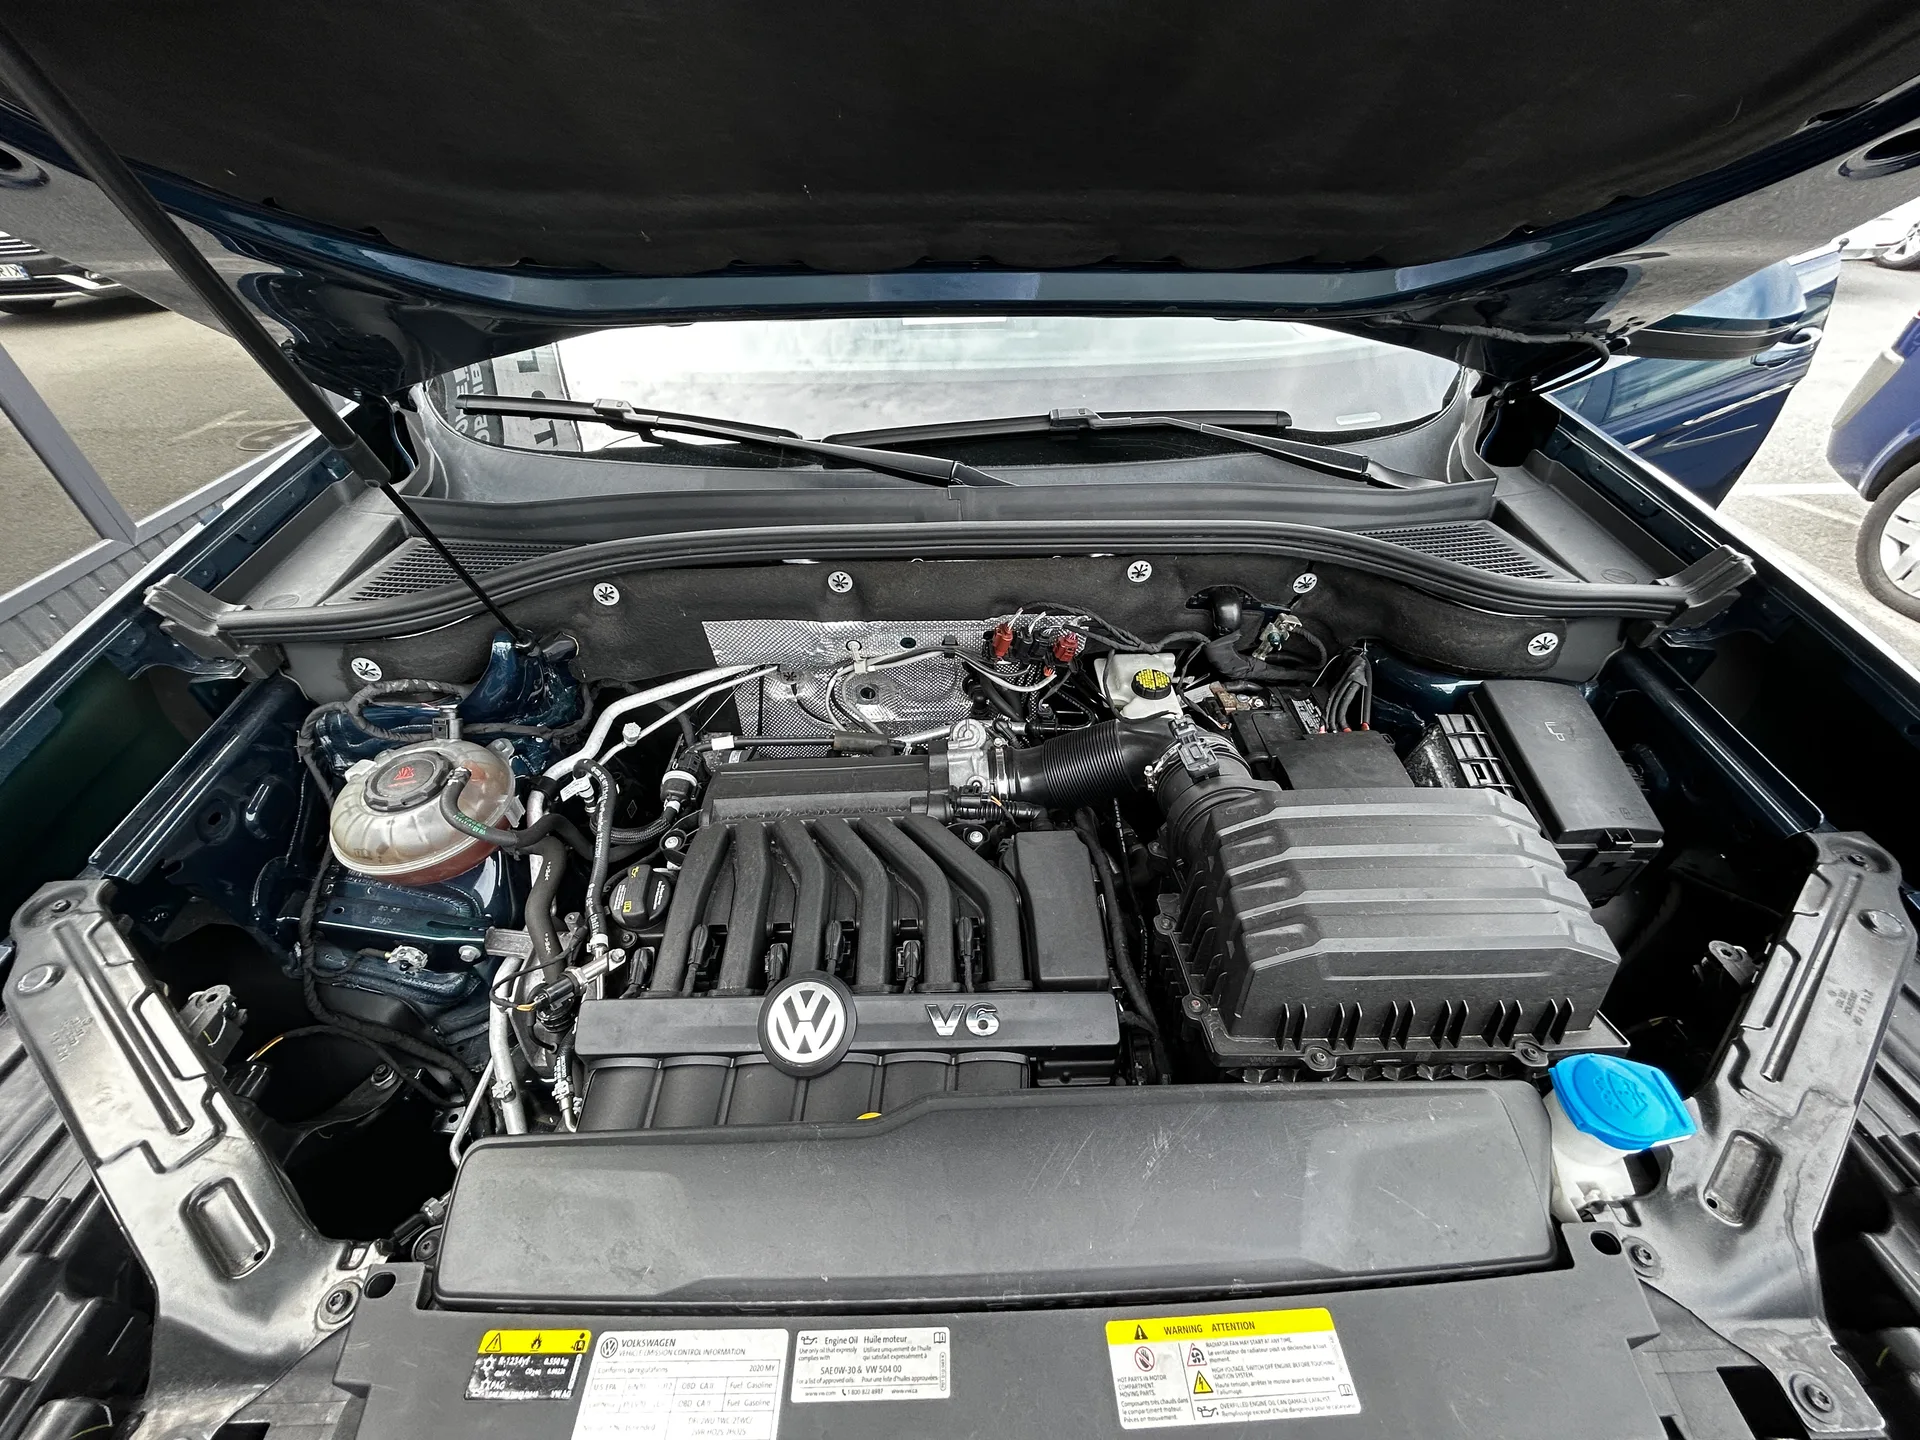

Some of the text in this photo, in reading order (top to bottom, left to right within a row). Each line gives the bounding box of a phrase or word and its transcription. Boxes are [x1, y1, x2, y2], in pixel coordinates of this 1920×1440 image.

[926, 1002, 999, 1037] V6
[1164, 1321, 1256, 1336] WARNING ATTENTION
[622, 1338, 676, 1348] VOLKSWAGEN
[824, 1337, 848, 1347] Engine
[864, 1335, 882, 1344] Huile
[821, 1366, 833, 1375] SAE
[866, 1365, 902, 1373] VW 504 00
